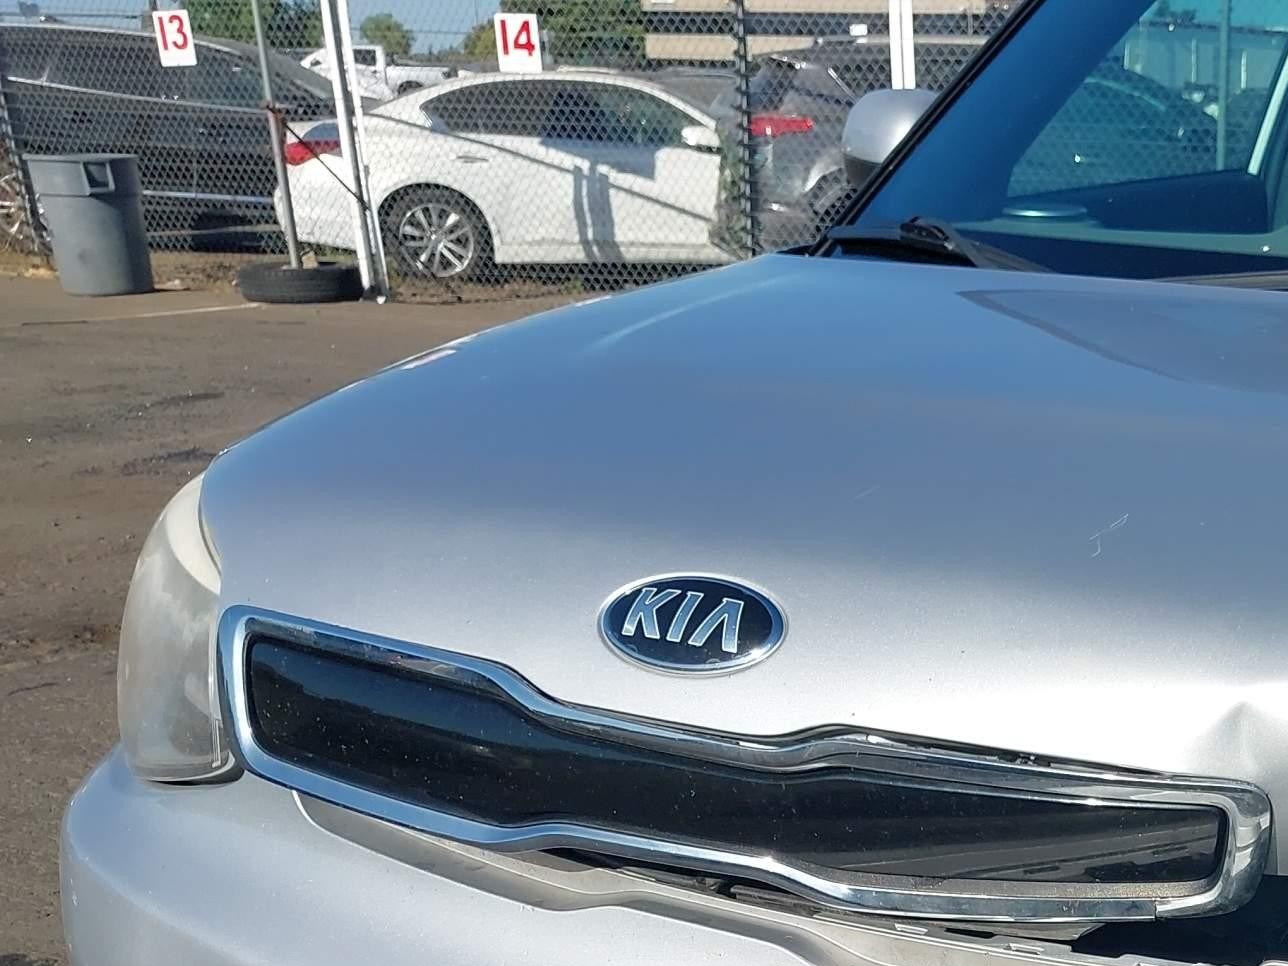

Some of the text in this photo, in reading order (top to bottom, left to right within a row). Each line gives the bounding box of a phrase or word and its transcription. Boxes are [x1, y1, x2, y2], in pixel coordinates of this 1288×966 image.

[158, 15, 188, 51] 13
[500, 20, 535, 56] 14
[621, 587, 745, 654] KIA
